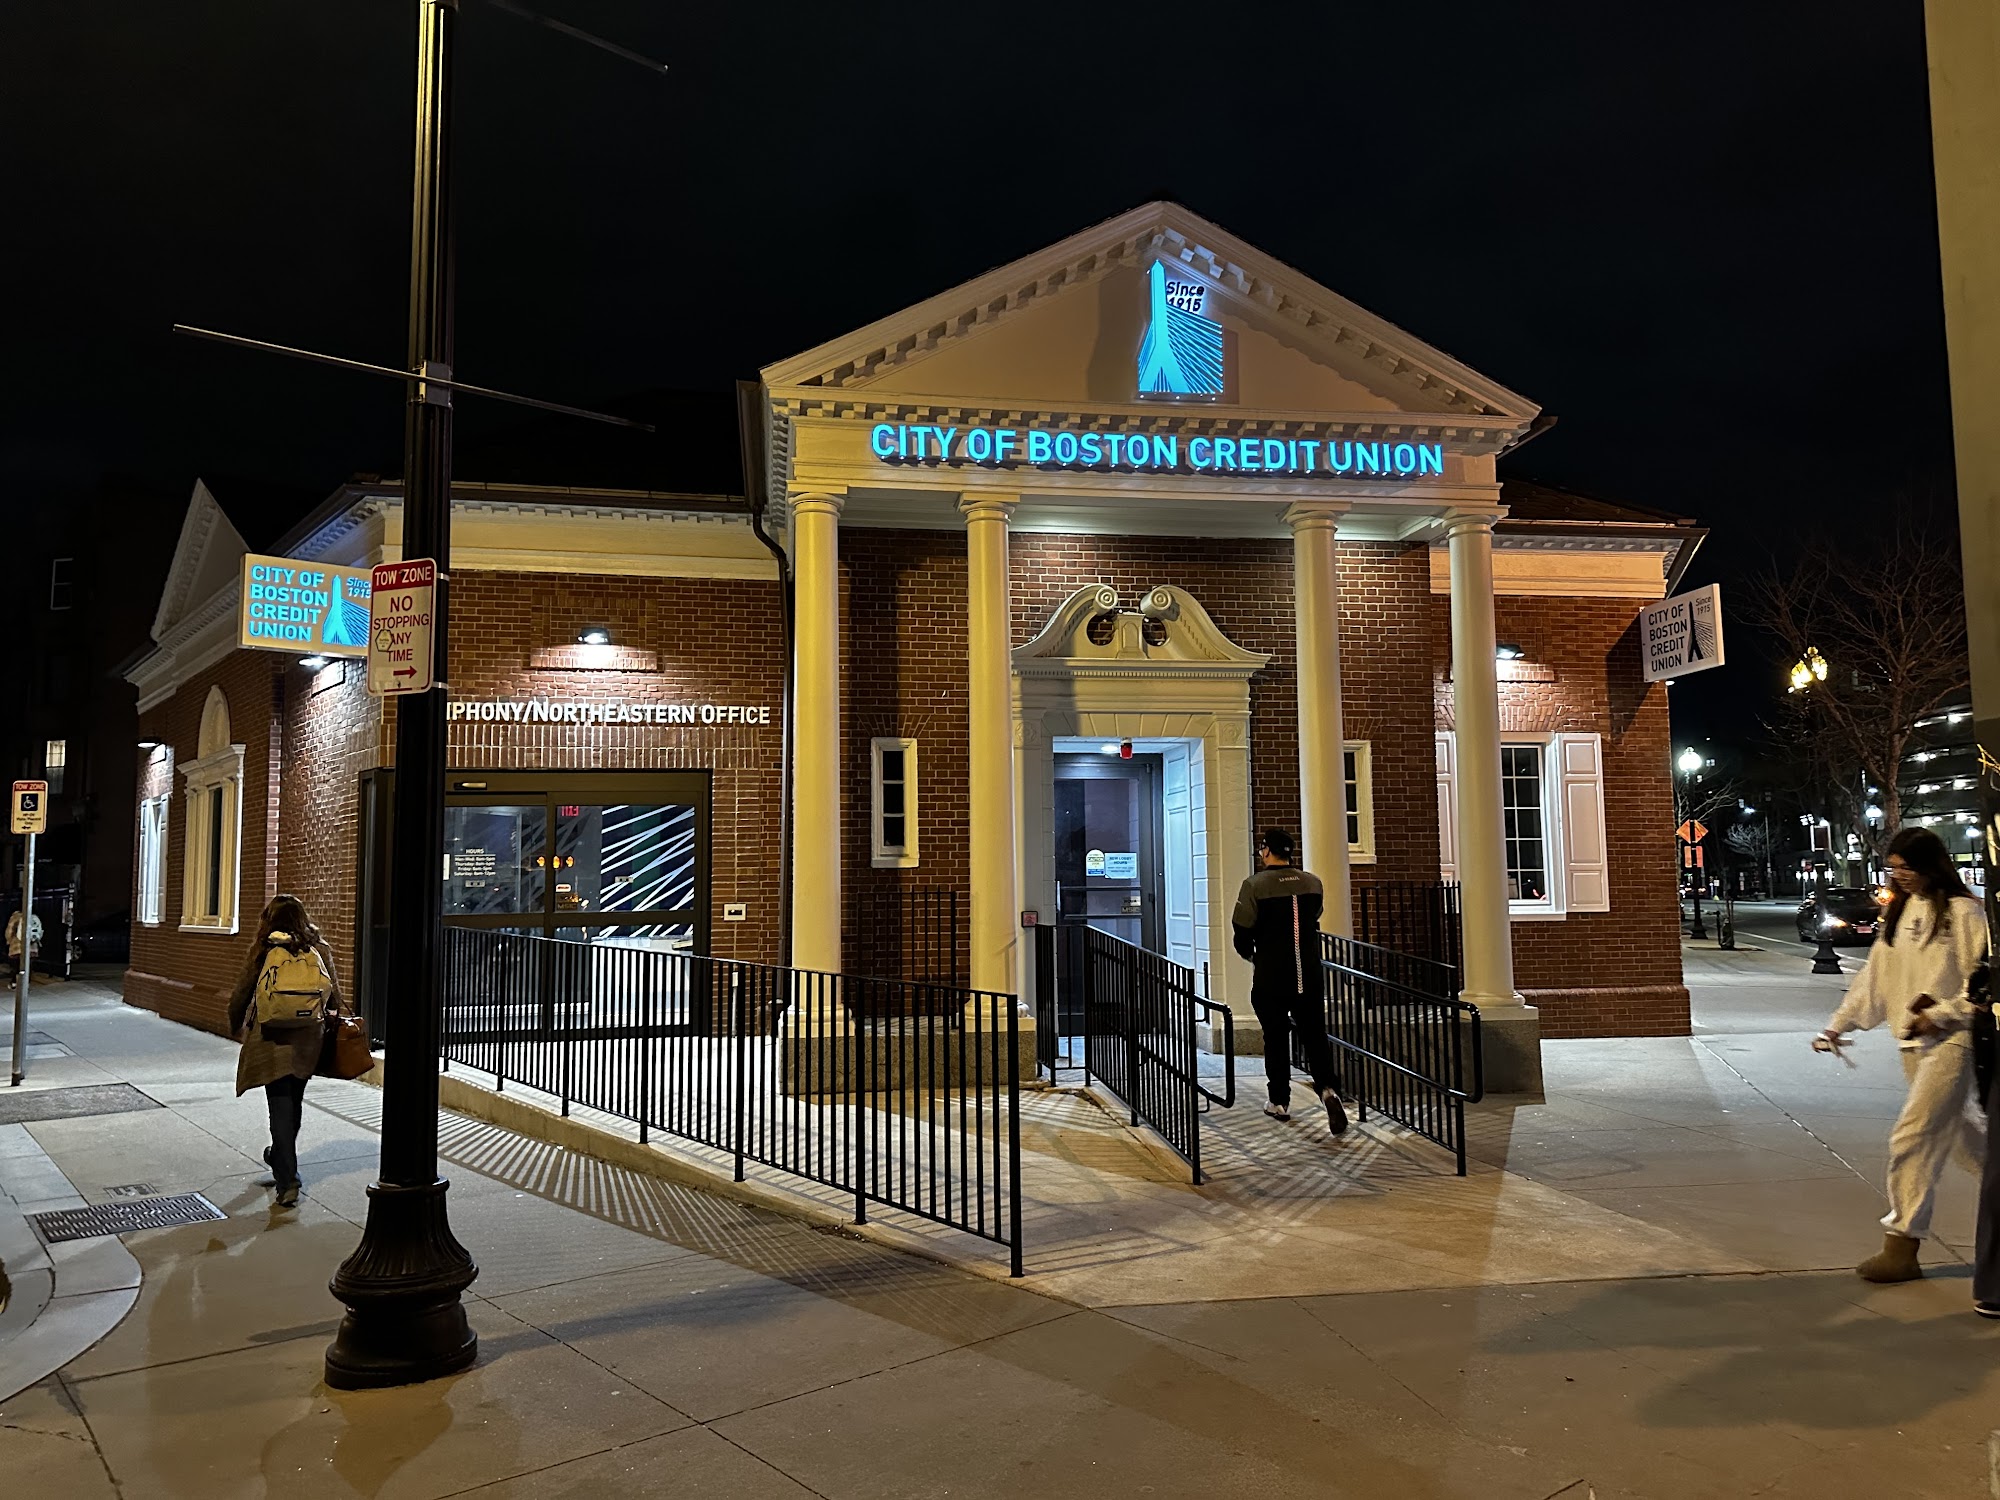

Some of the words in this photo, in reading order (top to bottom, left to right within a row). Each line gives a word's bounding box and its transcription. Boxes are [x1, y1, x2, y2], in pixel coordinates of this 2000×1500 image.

[1166, 281, 1205, 297] Since
[1168, 297, 1202, 312] 1915
[871, 423, 957, 459] CITY
[966, 428, 1017, 461] OF
[1028, 430, 1178, 467] BOSTON
[1188, 437, 1321, 472] CREDIT
[1328, 441, 1444, 475] UNION
[251, 565, 296, 585] CITY
[299, 571, 325, 588] OF
[346, 576, 371, 589] Sinc
[374, 571, 398, 586] TOW
[401, 566, 432, 584] ZONE
[250, 583, 328, 608] BOSTON
[389, 595, 413, 613] NO
[1695, 596, 1712, 607] Since
[249, 602, 322, 625] CREDIT
[1648, 608, 1669, 626] CITY
[1671, 603, 1684, 618] OF
[1696, 604, 1711, 616] 1915
[248, 620, 312, 643] UNION
[373, 613, 430, 631] STOPPING
[1649, 618, 1688, 641] BOSTON
[387, 648, 413, 663] TIME
[1650, 636, 1685, 657] CREDIT
[1651, 653, 1682, 673] UNION
[446, 700, 696, 725] PHONY/NORTHEASTERN
[701, 703, 771, 725] OFFICE
